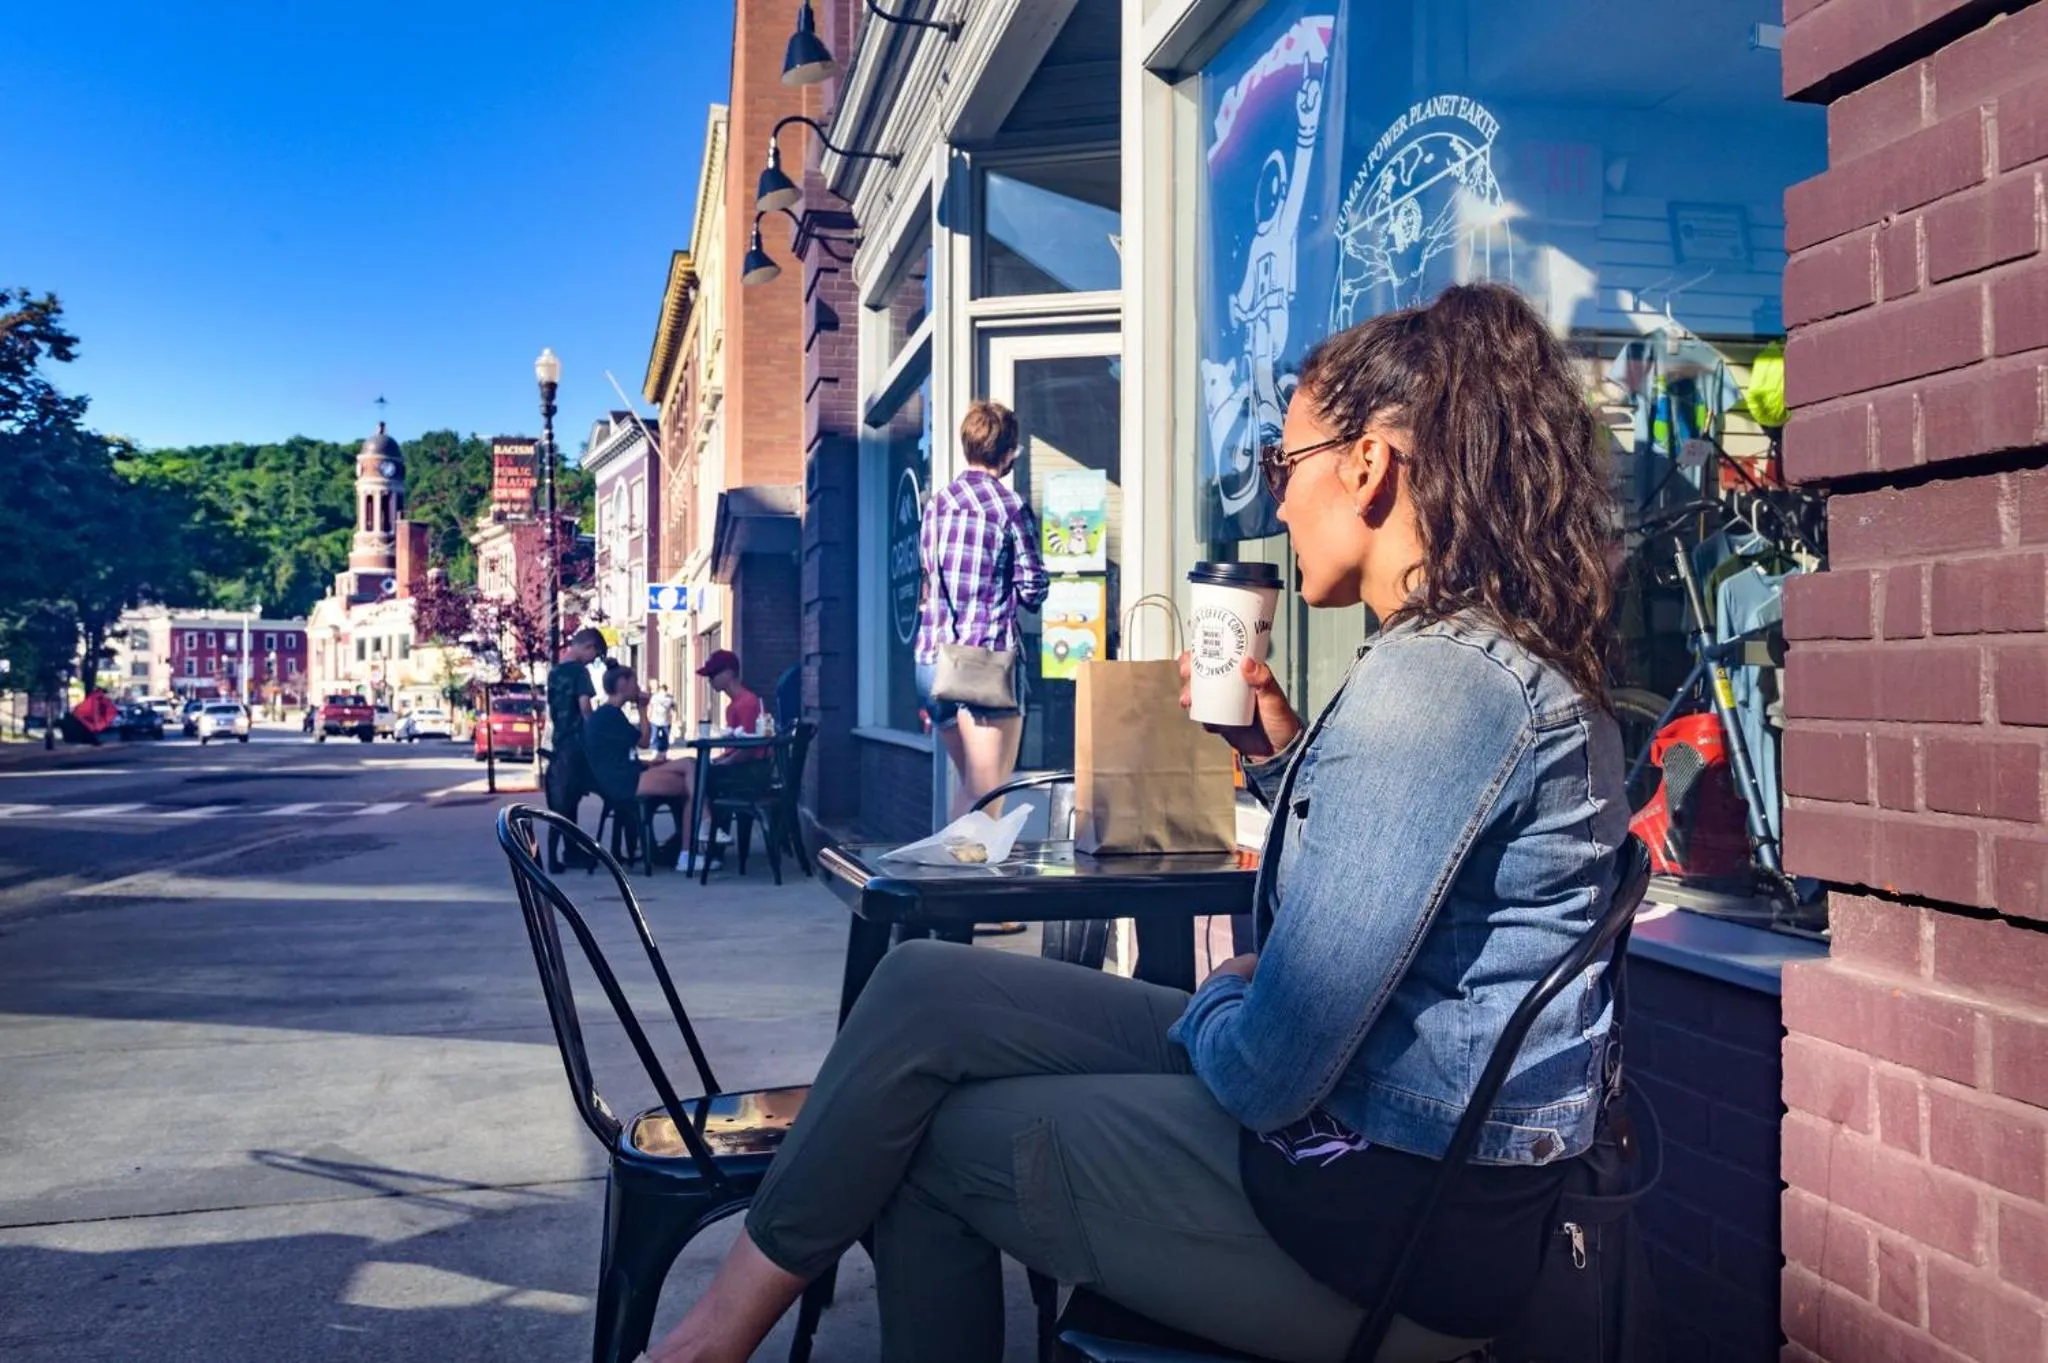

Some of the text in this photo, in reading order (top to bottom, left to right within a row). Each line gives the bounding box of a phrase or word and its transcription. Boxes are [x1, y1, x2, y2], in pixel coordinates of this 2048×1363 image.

[1334, 95, 1500, 238] HUMAN POWER PLANET EARTH
[1227, 618, 1245, 657] COMPANY
